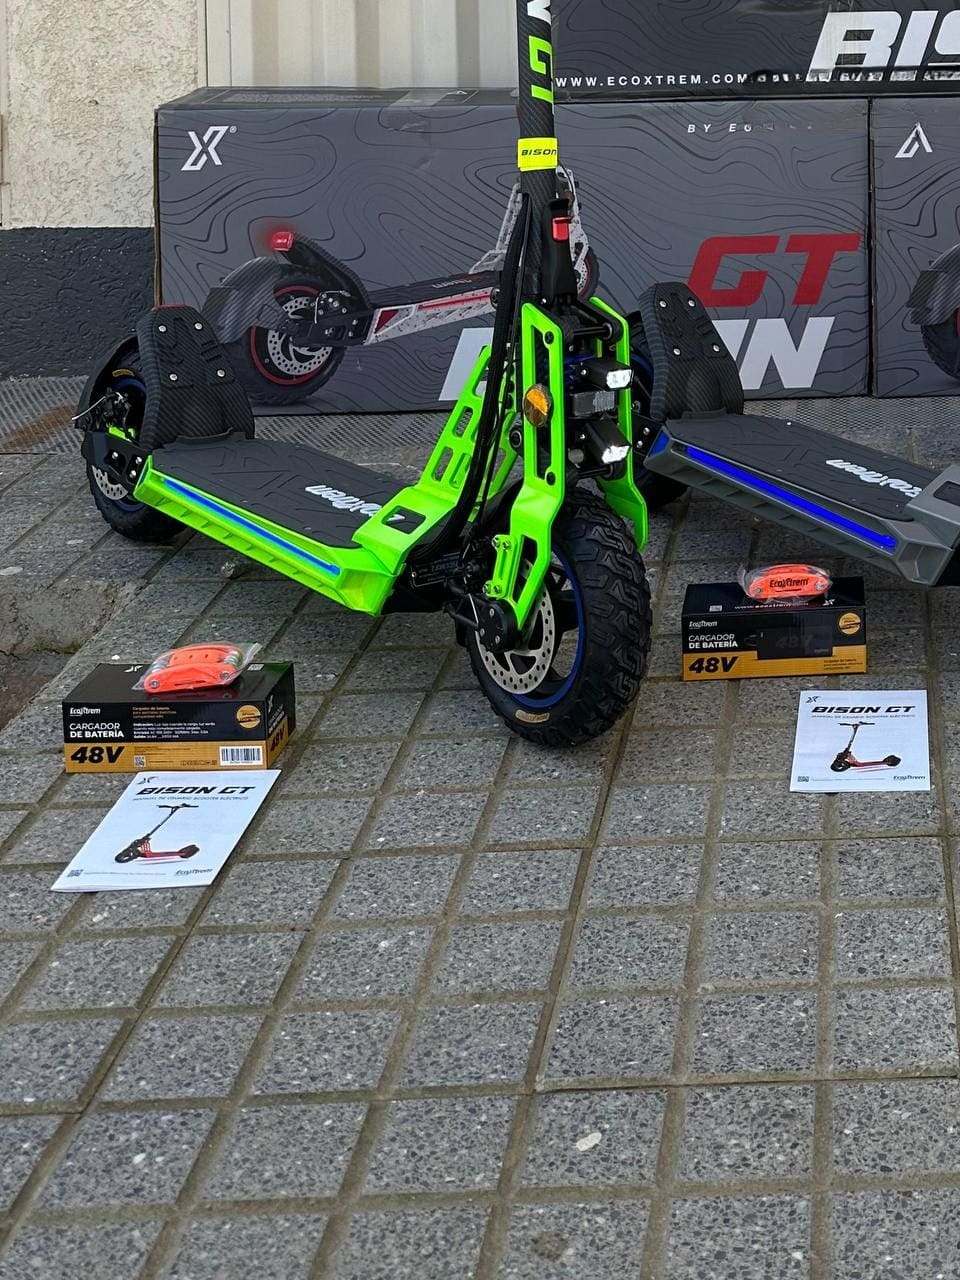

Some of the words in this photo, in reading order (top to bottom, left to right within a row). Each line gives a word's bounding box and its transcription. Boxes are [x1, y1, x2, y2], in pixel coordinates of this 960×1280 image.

[556, 73, 747, 87] WWW.ECOXTREM.COM
[687, 123, 711, 133] BY
[685, 233, 861, 307] GT
[688, 634, 735, 642] CARGADOR
[702, 640, 738, 649] BATERÍA
[688, 656, 739, 673] 48V
[812, 706, 881, 714] BISON
[69, 722, 120, 730] CARGADOR
[84, 729, 124, 738] BATERÍA
[71, 746, 125, 763] 48V
[136, 786, 217, 795] BISON
[218, 786, 256, 794] GT
